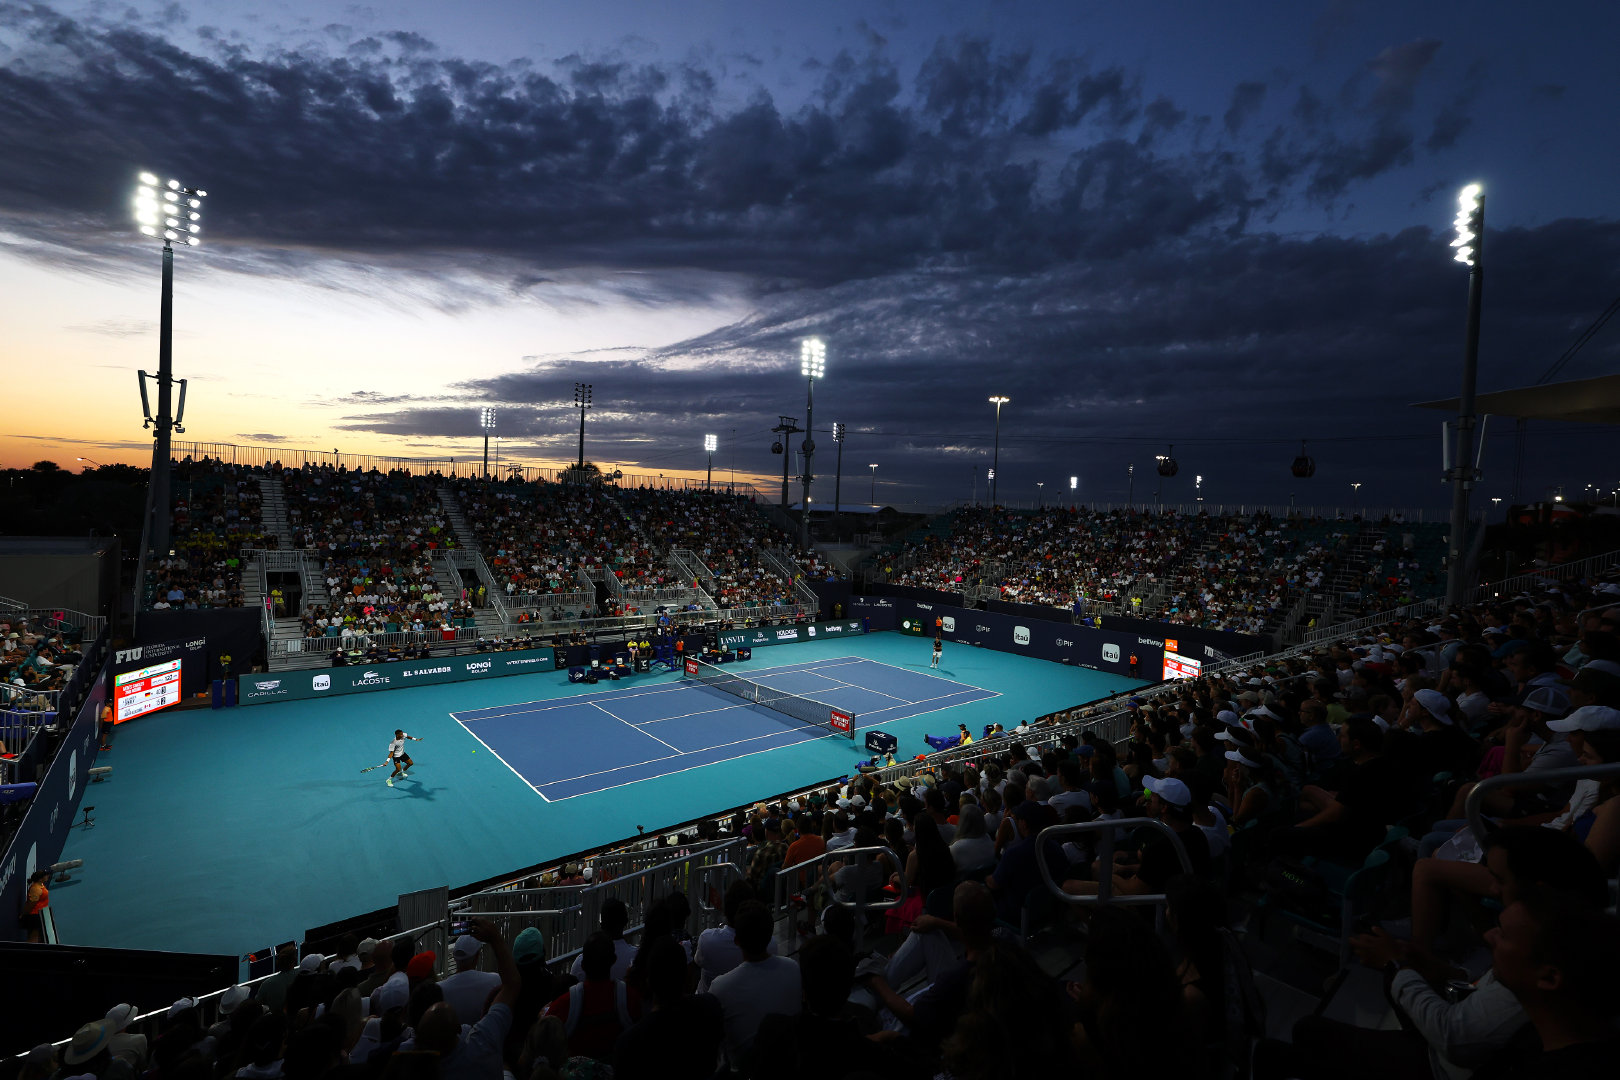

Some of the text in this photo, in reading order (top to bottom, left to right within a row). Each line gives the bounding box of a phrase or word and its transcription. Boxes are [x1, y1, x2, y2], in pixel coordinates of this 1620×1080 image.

[916, 603, 933, 611] betway
[1015, 632, 1028, 641] itaú
[1138, 637, 1164, 648] betway
[115, 647, 143, 664] FIU
[1103, 650, 1119, 660] itaú
[414, 666, 452, 676] SALVADOR
[314, 680, 329, 688] itaú
[352, 676, 391, 687] LACOSTE
[247, 689, 288, 698] CADILLAC
